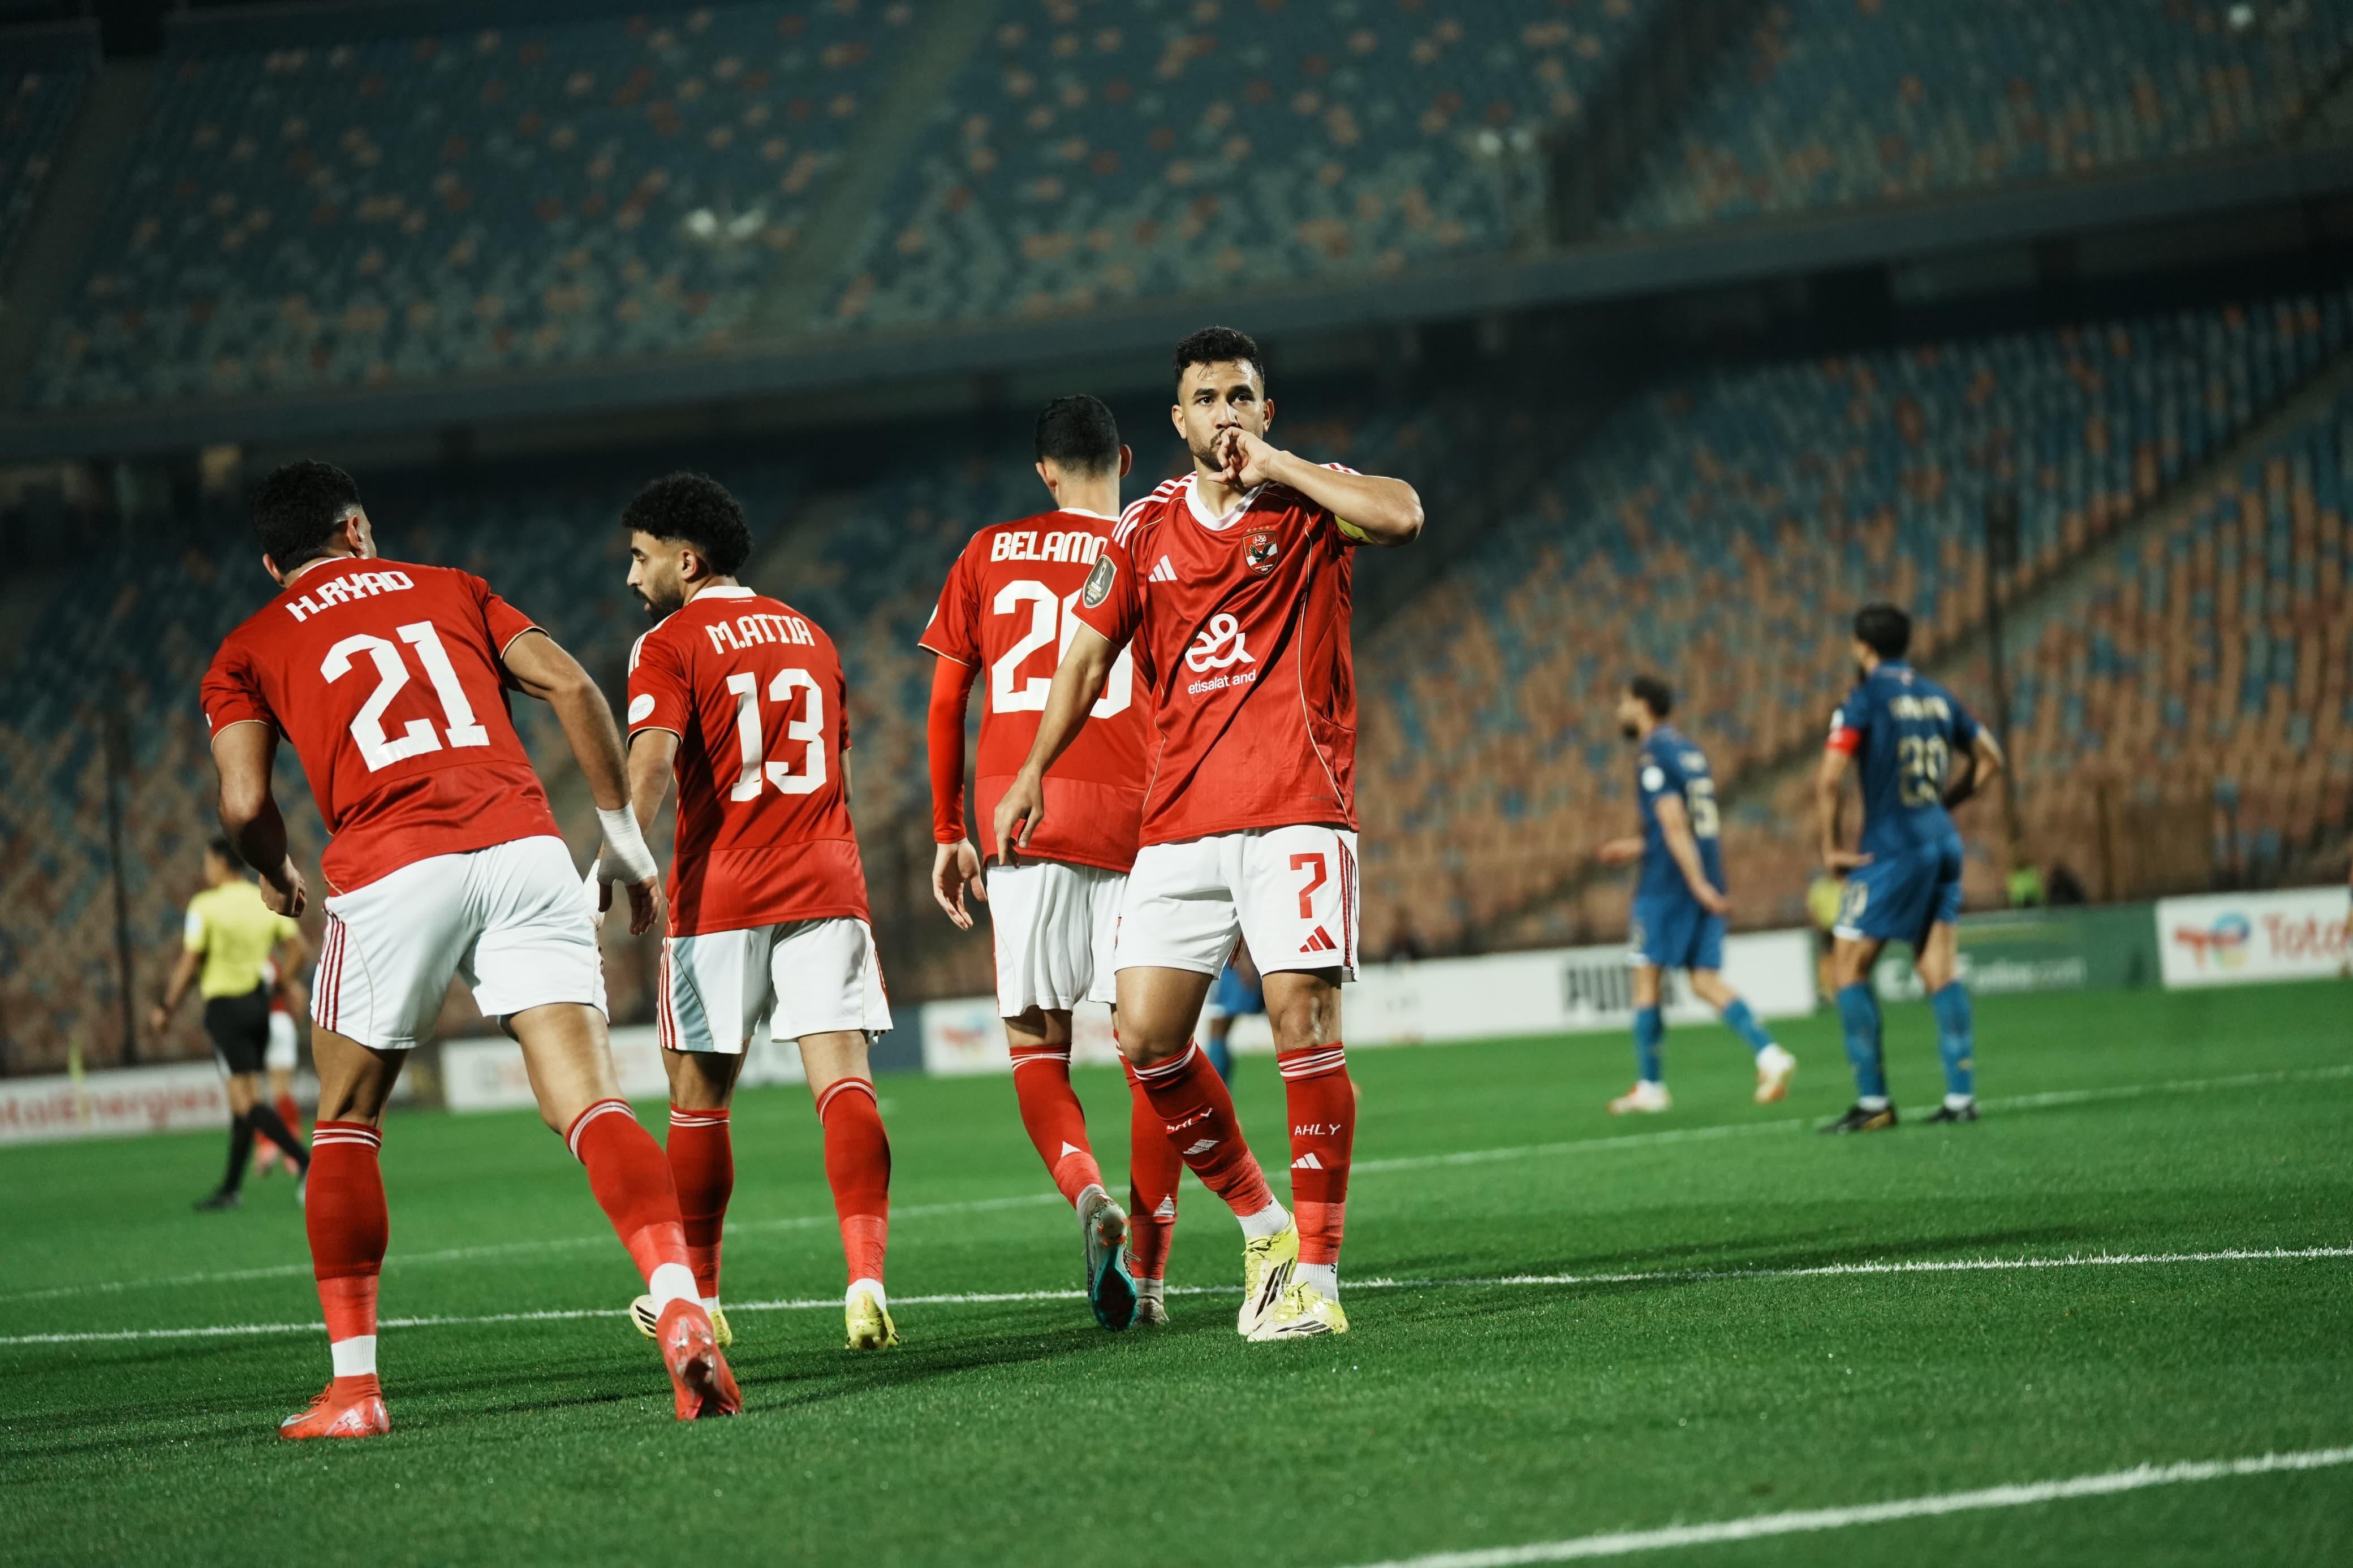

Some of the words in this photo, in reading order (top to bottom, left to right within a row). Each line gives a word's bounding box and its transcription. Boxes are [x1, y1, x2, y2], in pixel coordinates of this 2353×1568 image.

[285, 571, 415, 623] H.RYAD
[705, 614, 816, 655] M.ATTIA
[320, 621, 490, 773] 21
[1188, 675, 1230, 694] etisalat
[1232, 669, 1256, 685] and
[726, 668, 828, 802] 13
[1294, 1123, 1341, 1136] AHLY
